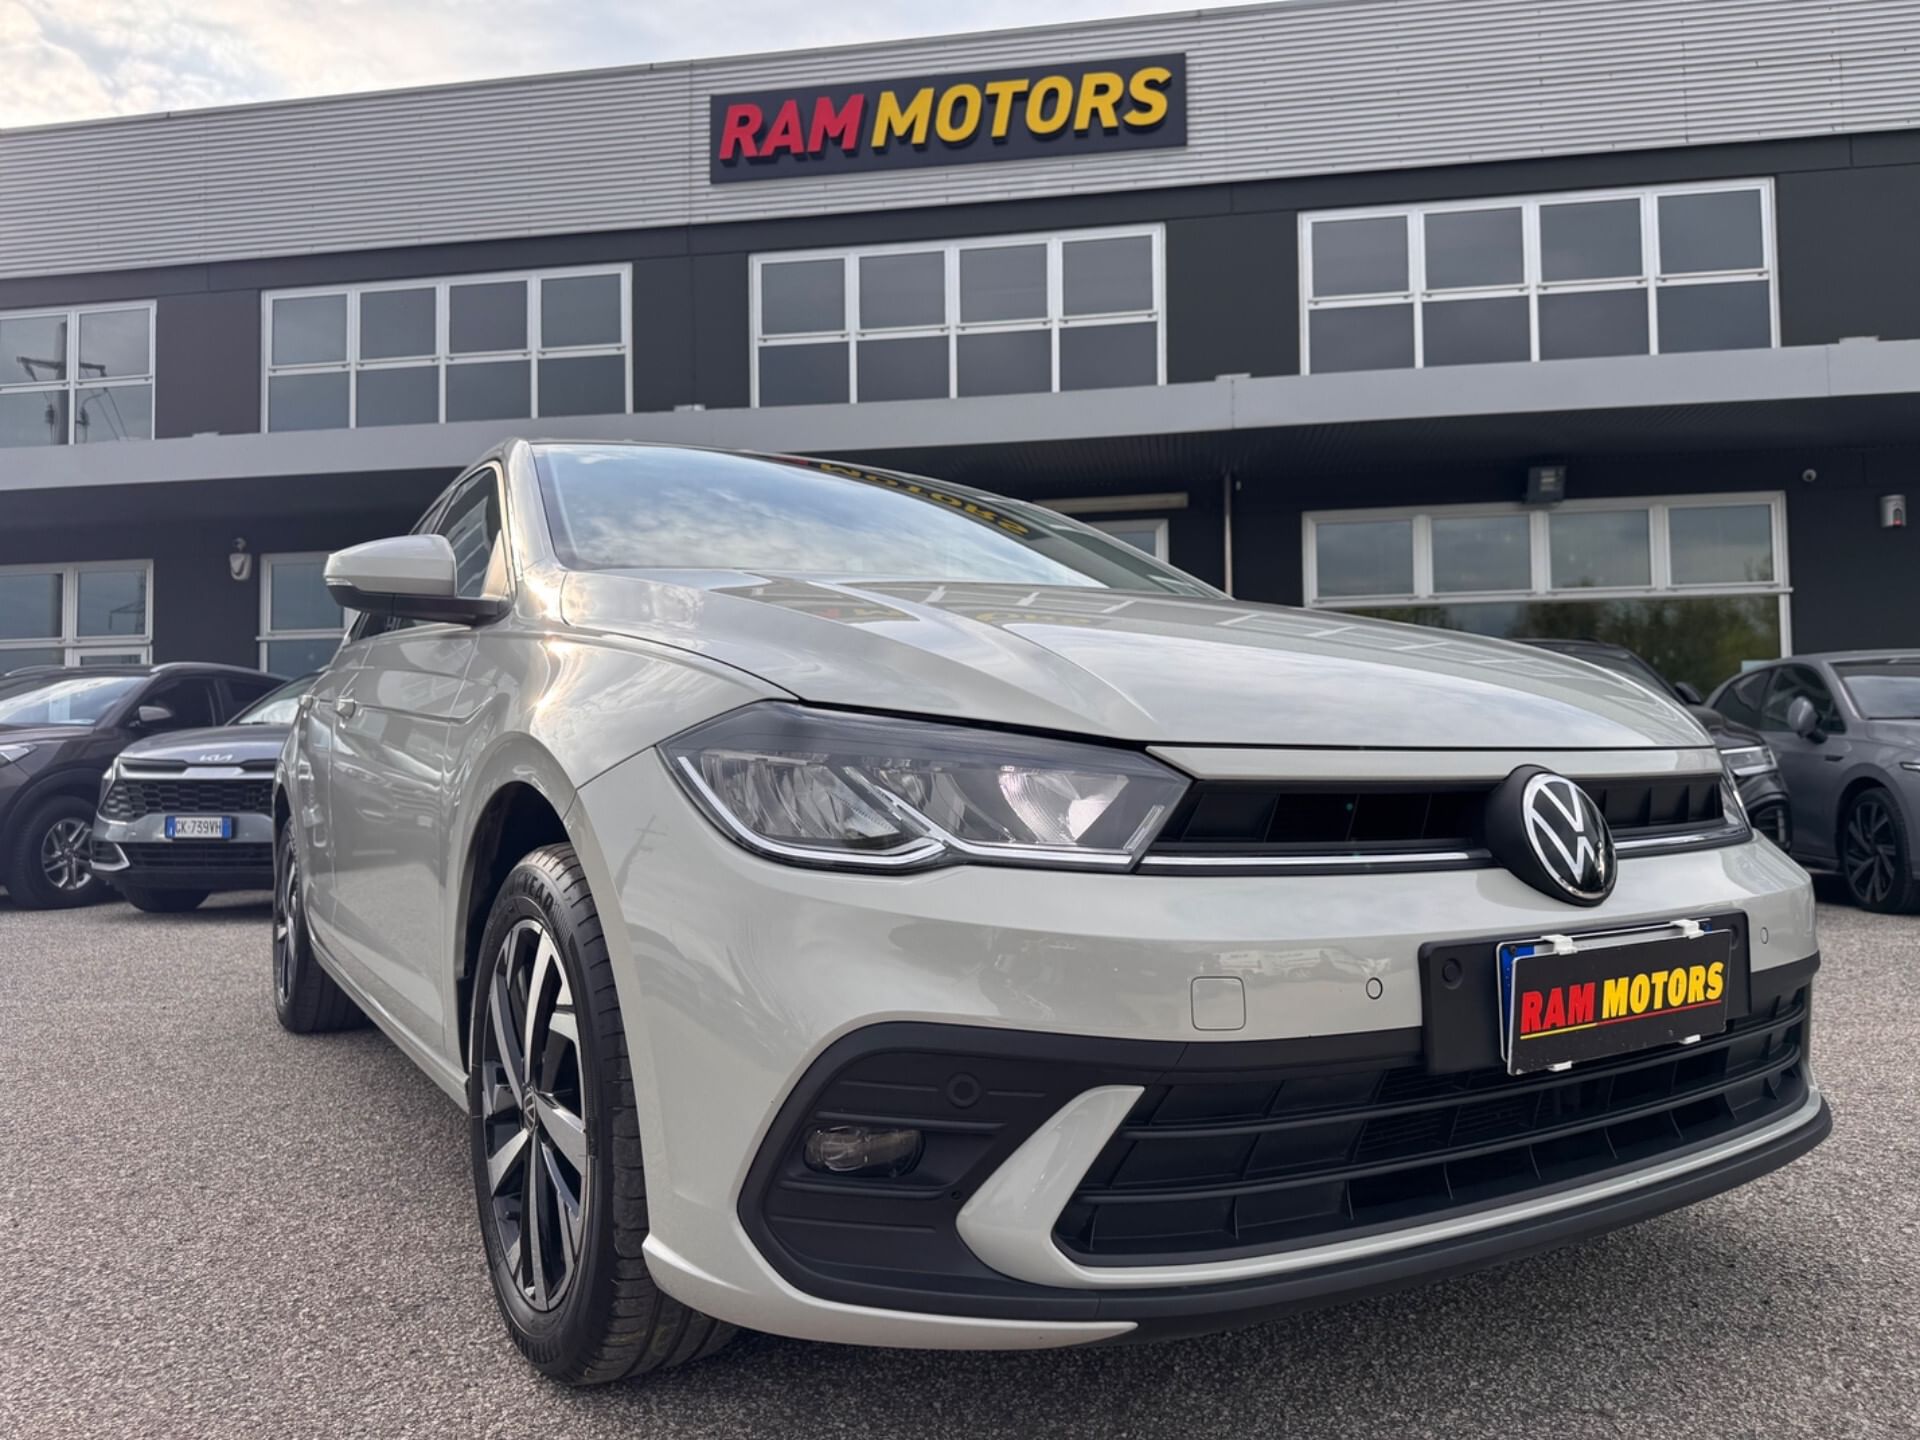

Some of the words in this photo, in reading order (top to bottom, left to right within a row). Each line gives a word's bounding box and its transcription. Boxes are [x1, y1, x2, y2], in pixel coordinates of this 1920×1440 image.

[719, 95, 865, 160] RAM
[871, 67, 1172, 148] MOTORS
[1520, 982, 1596, 1034] RAM
[1601, 961, 1725, 1020] MOTORS
